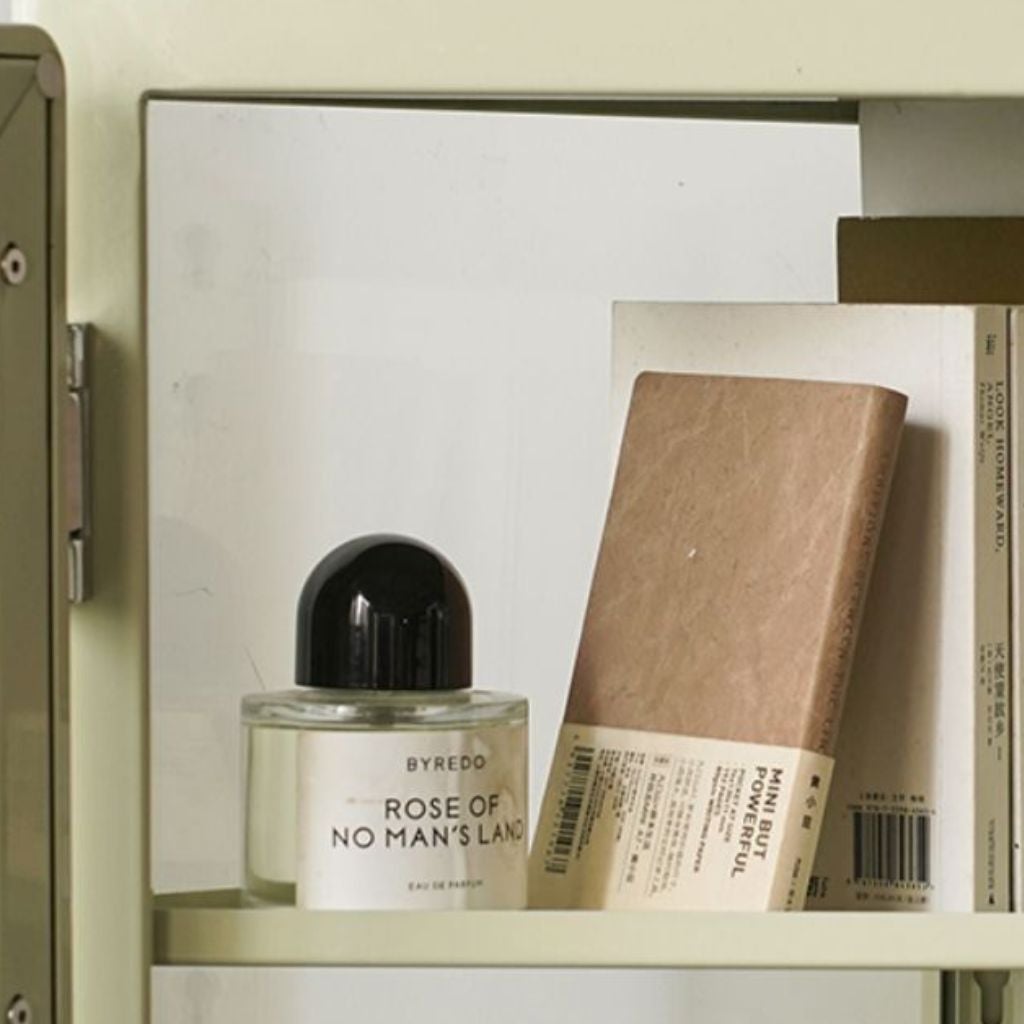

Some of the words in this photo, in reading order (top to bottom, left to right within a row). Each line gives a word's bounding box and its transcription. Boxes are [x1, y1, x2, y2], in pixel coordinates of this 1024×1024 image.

[407, 754, 486, 771] BYREDO
[384, 797, 460, 820] ROSE
[468, 794, 499, 818] OF
[762, 767, 784, 814] MINI
[332, 826, 375, 849] NO
[478, 819, 524, 845] LAND
[730, 765, 768, 880] POWERFUL
[752, 819, 773, 860] BUT
